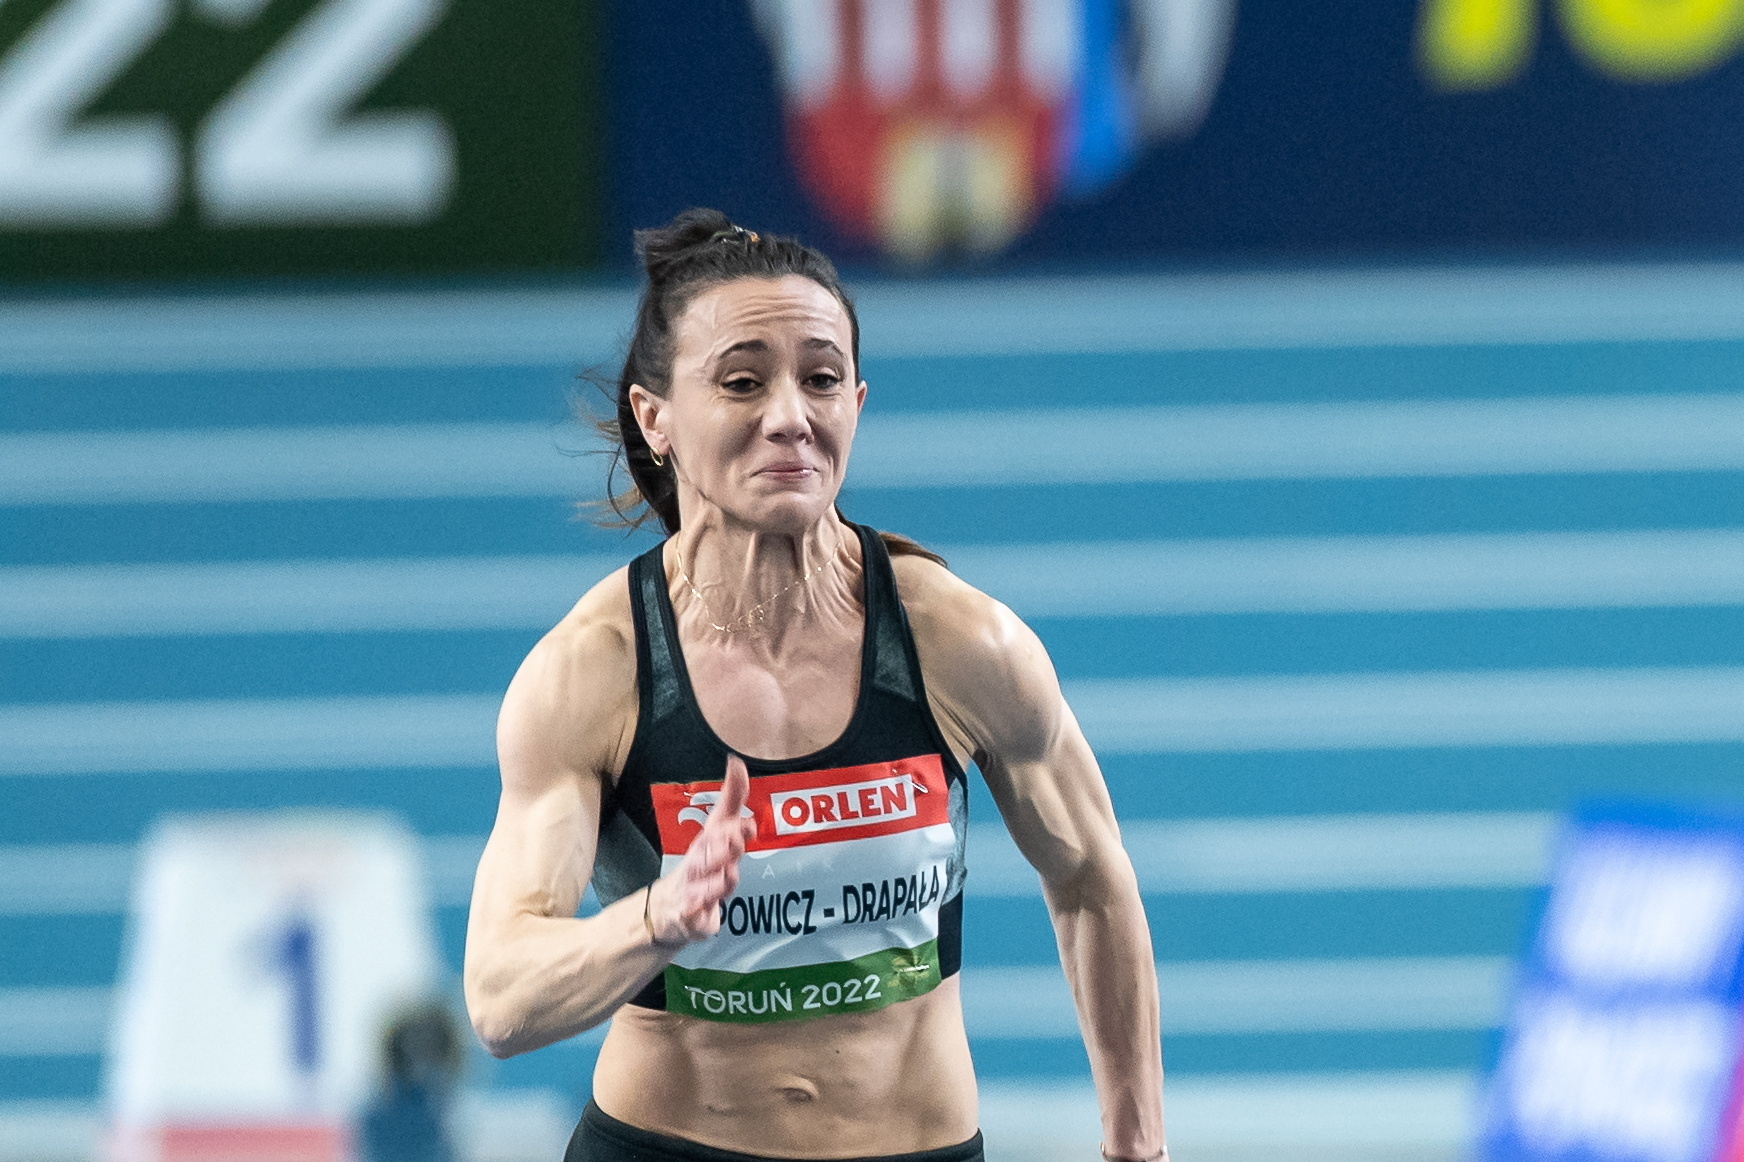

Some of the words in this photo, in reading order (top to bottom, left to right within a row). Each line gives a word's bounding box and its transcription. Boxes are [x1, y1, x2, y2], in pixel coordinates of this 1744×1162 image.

[781, 782, 909, 827] ORLEN
[842, 865, 940, 924] DRAPAŁA
[242, 895, 324, 1080] 1
[686, 982, 794, 1015] TORUŃ
[801, 973, 882, 1011] 2022
